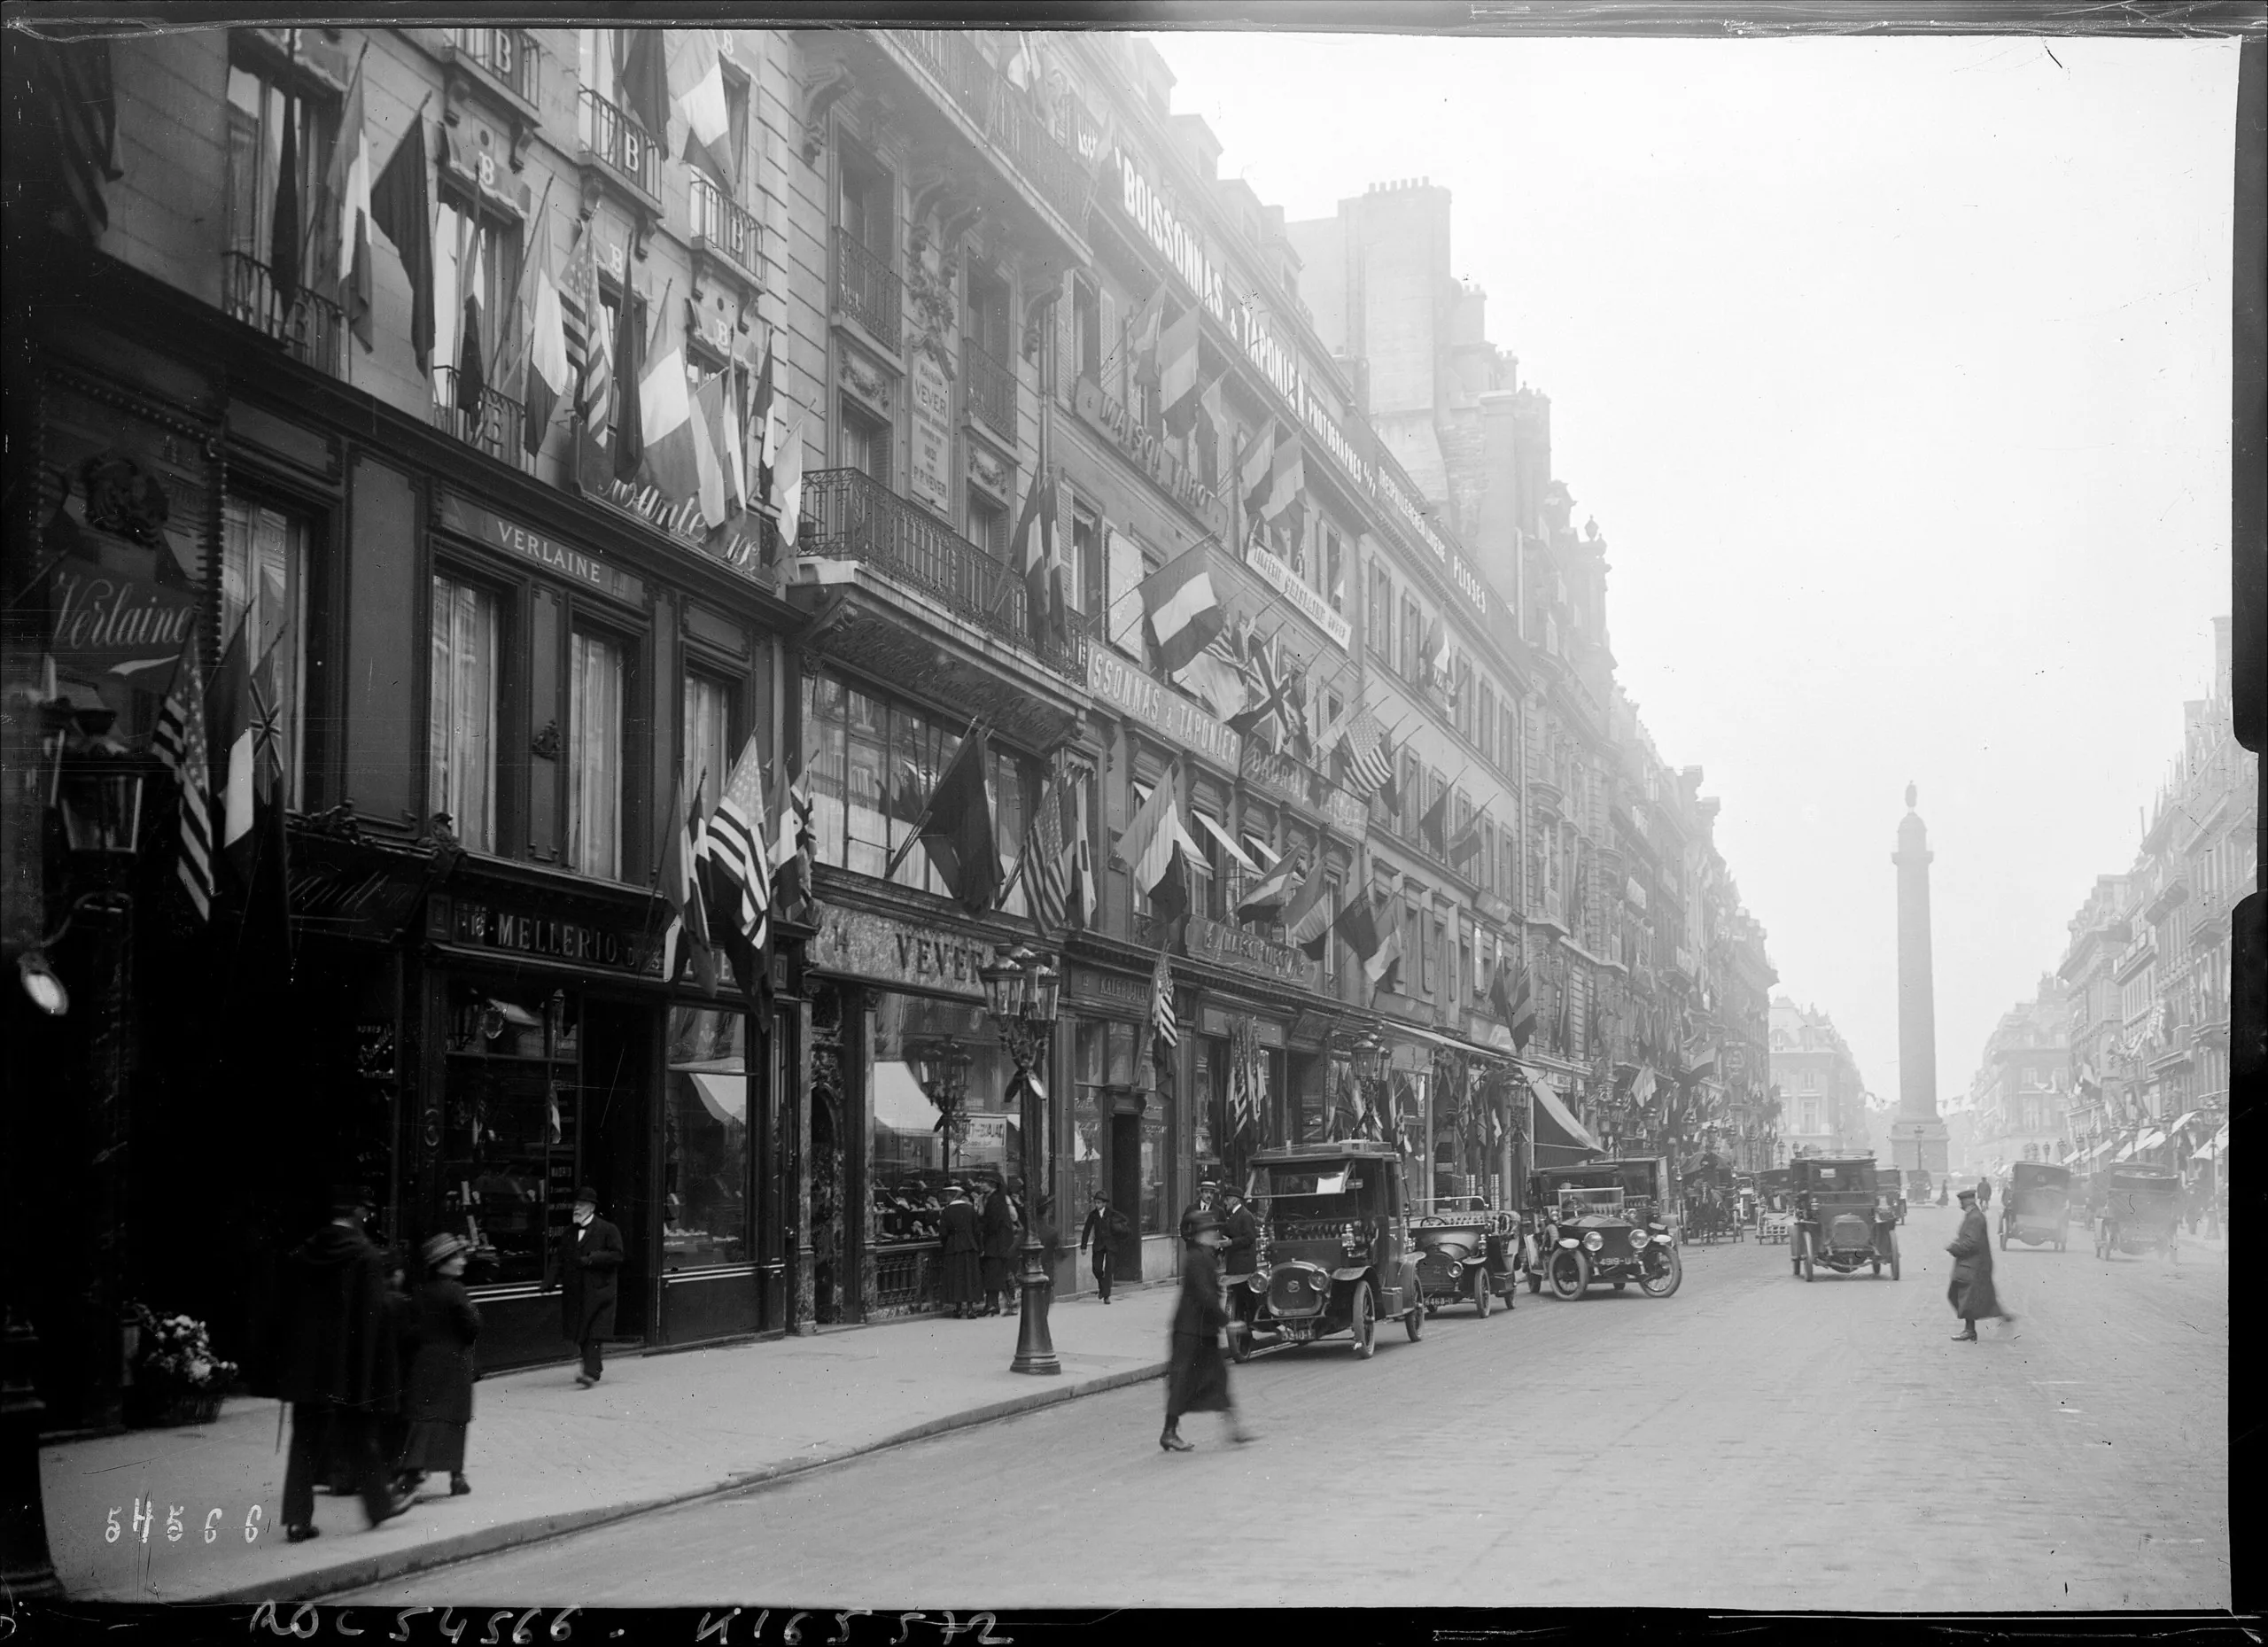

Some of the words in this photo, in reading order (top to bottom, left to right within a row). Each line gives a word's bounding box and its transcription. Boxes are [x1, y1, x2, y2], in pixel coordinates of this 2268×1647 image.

[495, 31, 512, 74] B
[478, 151, 496, 186] B
[625, 131, 639, 172] B
[731, 217, 744, 253] B
[1124, 155, 1223, 322] BOISSONNAS
[1229, 307, 1238, 341] &
[610, 244, 625, 275] B
[717, 317, 729, 346] B
[915, 378, 947, 419] VEVER
[1099, 394, 1163, 477] MAISON
[498, 520, 602, 585] VERLAINE
[50, 570, 193, 649] Verlaine
[1088, 646, 1161, 723] ISSONNAS
[1165, 705, 1173, 730] &
[1179, 703, 1238, 765] TAPONIER
[497, 913, 618, 964] MELLERIO
[896, 933, 983, 983] VEVER
